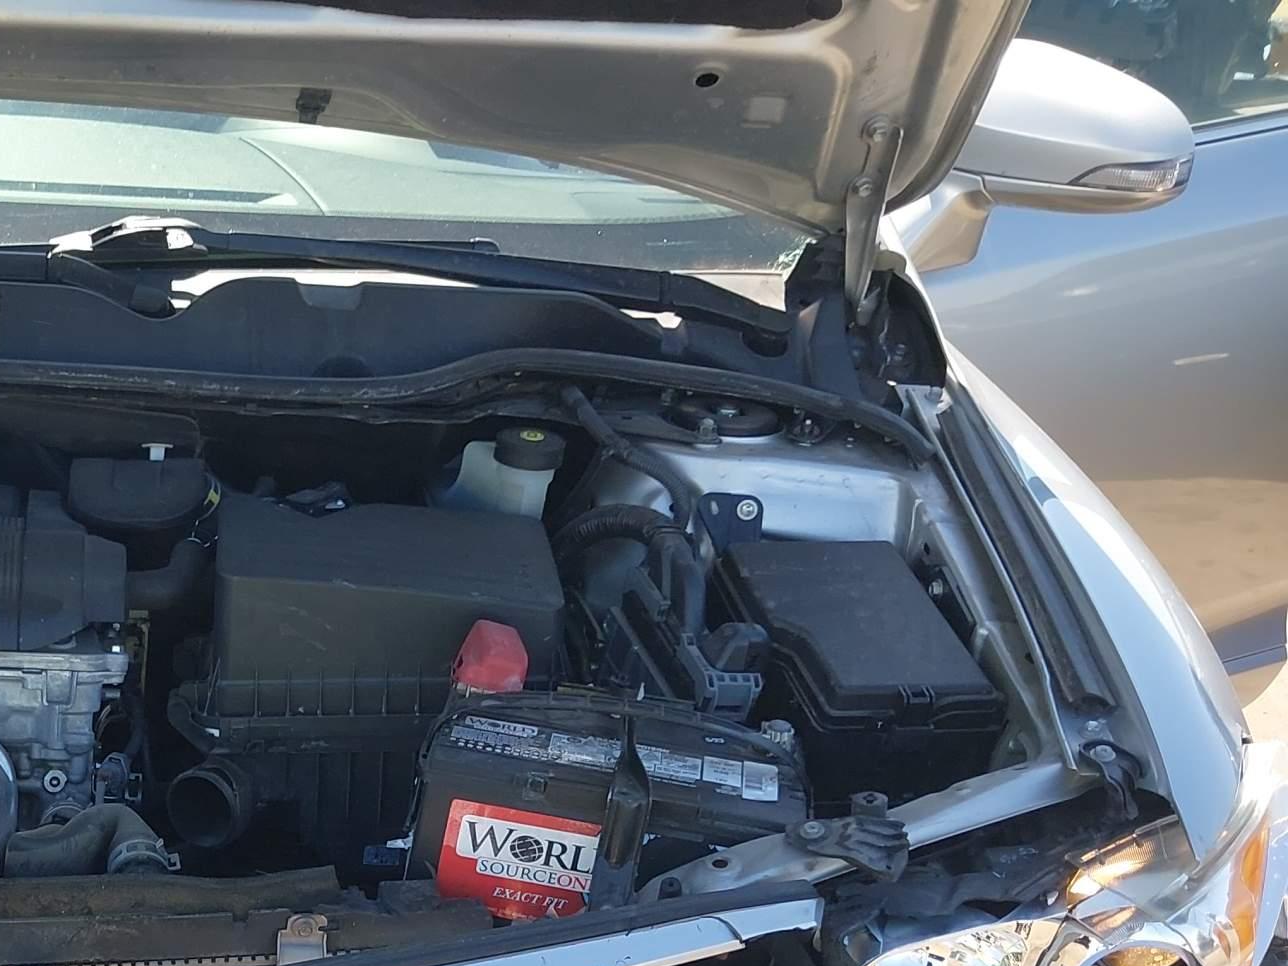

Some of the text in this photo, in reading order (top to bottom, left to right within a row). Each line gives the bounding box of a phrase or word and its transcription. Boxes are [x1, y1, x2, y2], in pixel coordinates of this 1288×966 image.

[466, 820, 596, 875] WORL
[478, 859, 592, 891] SOURCEON
[492, 886, 569, 910] EXACT FIT
